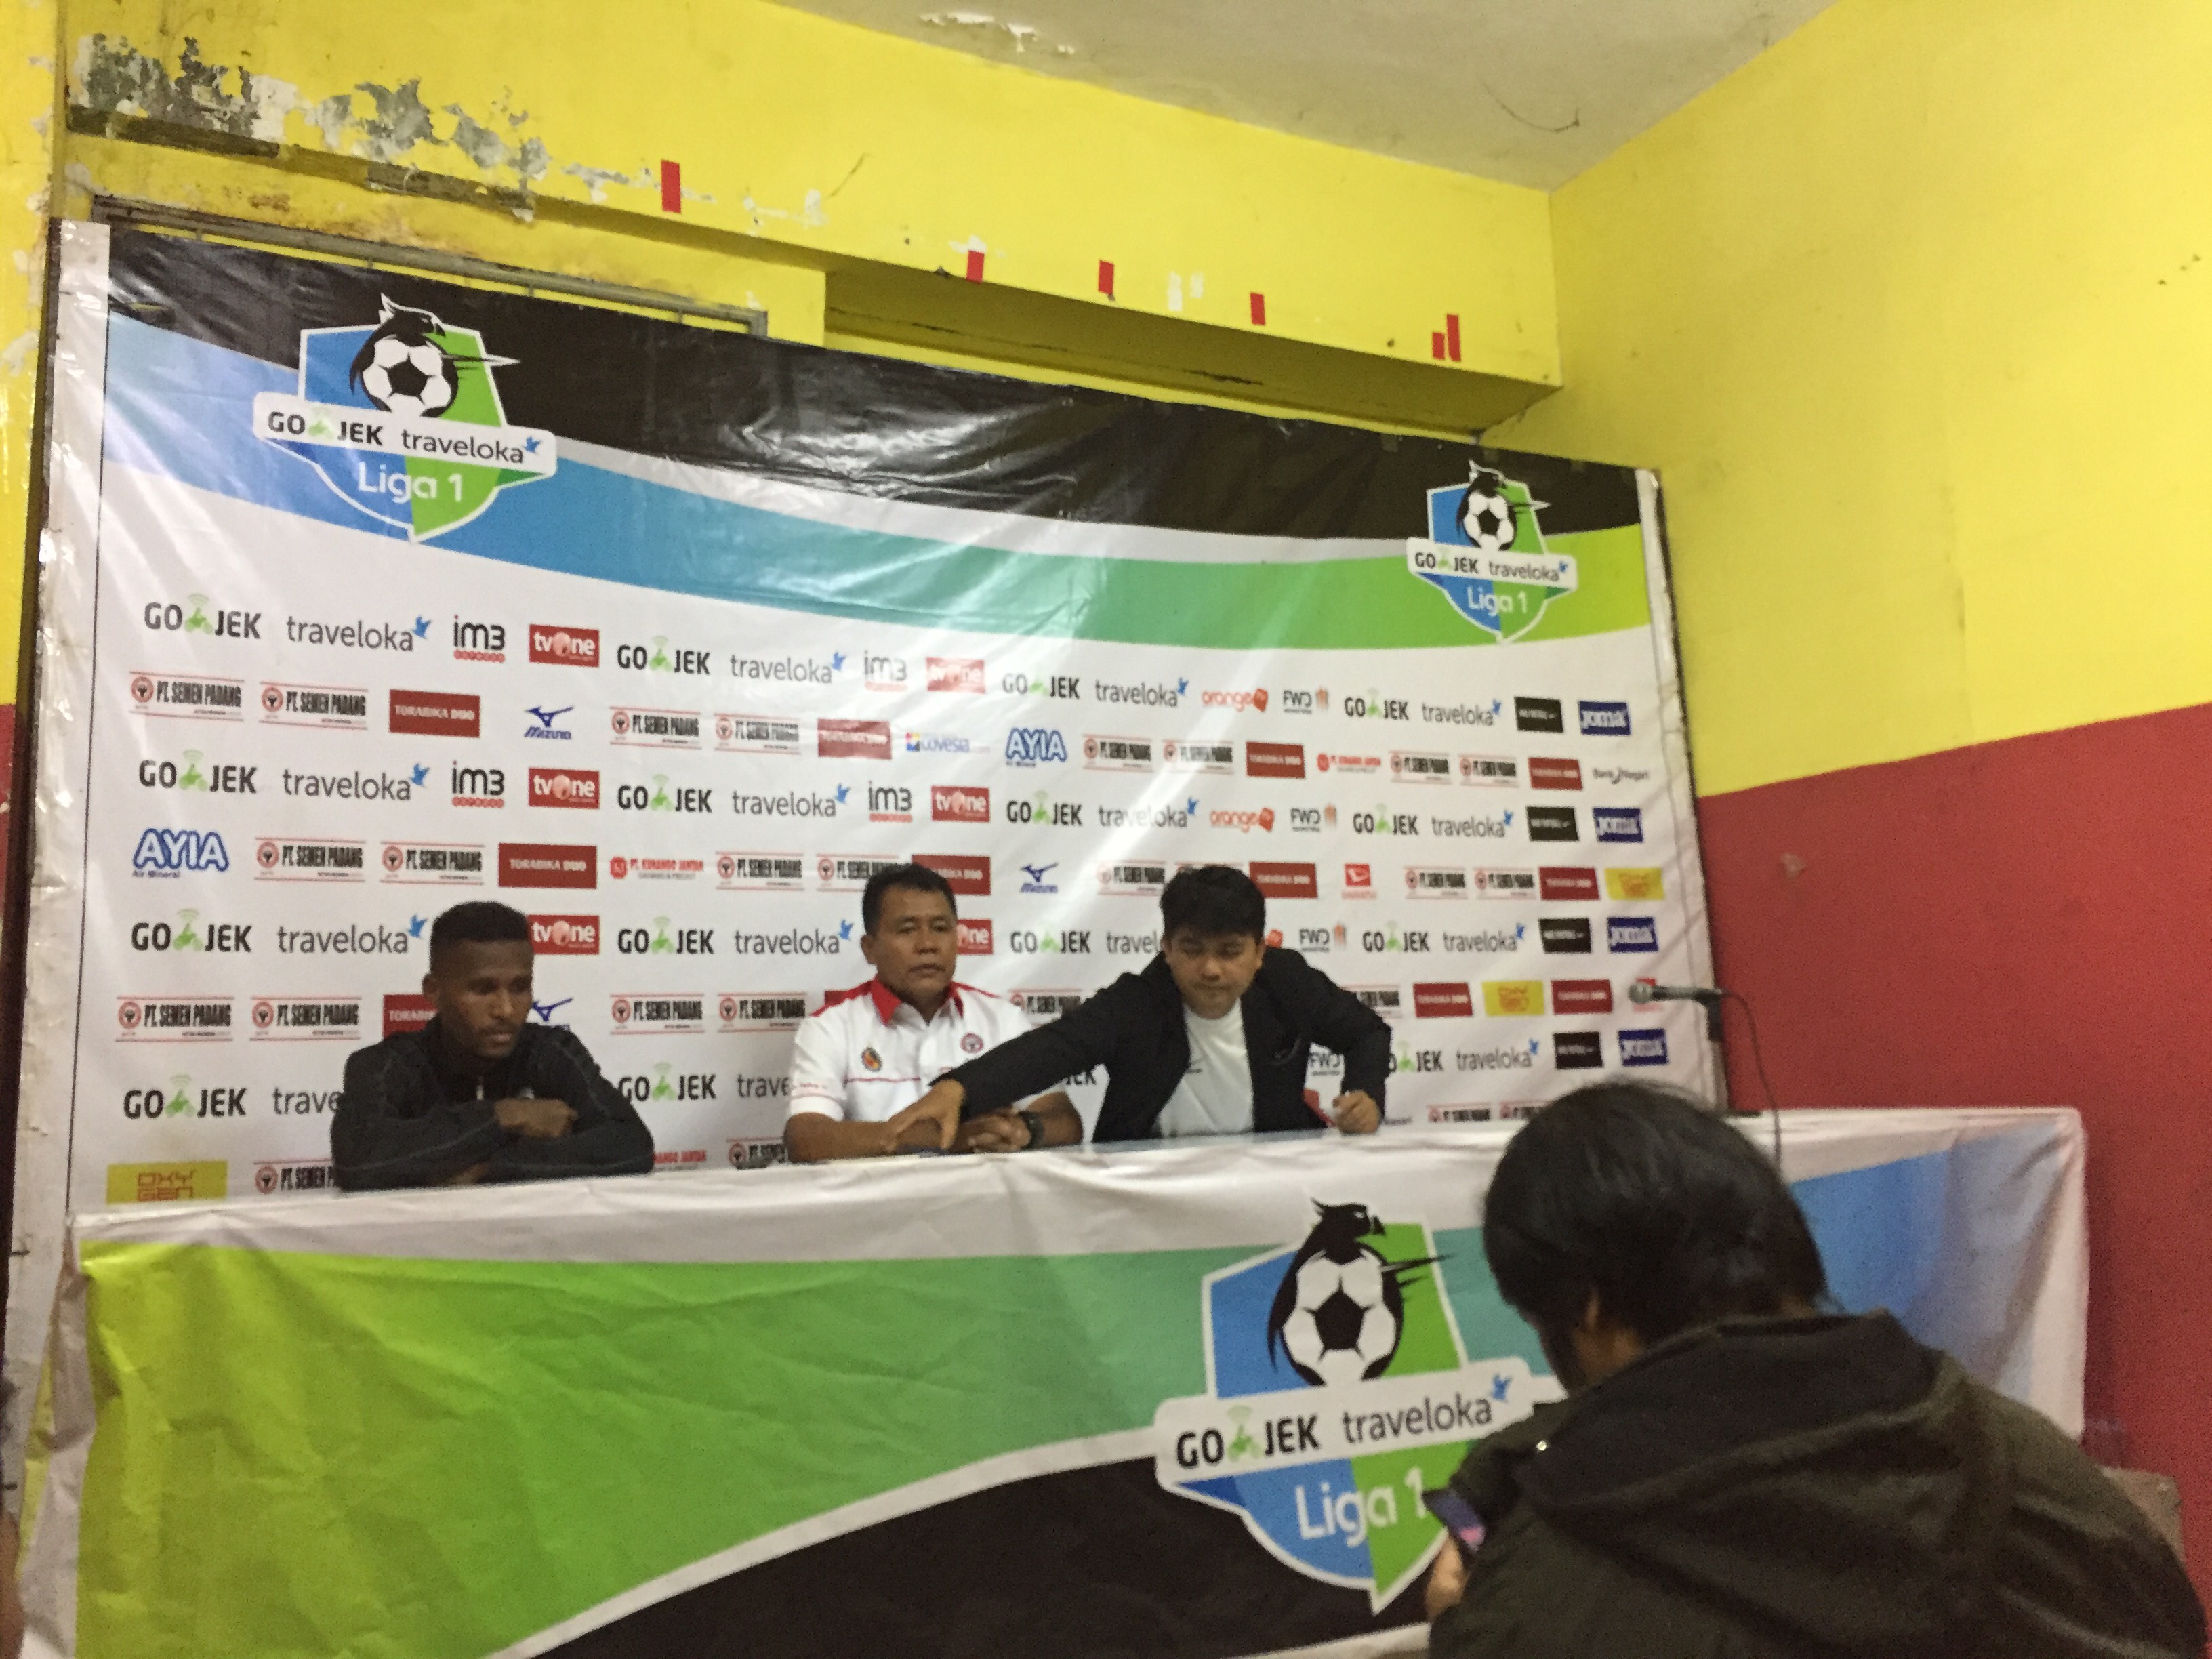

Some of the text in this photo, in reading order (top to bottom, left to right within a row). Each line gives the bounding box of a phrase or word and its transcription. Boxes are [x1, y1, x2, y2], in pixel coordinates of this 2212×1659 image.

[268, 411, 523, 464] GO JEK traveloka
[359, 462, 463, 504] Liga 1
[1489, 560, 1559, 582] traveloka
[1467, 586, 1528, 617] Liga 1
[286, 615, 413, 651] traveloka
[453, 614, 505, 651] im3
[533, 631, 595, 657] tvOne
[731, 654, 832, 684] traveloka
[864, 650, 907, 682] im3
[1095, 678, 1178, 708] traveloka
[1422, 702, 1494, 726] traveloka
[1006, 728, 1067, 762] AYIA
[283, 768, 411, 801] traveloka
[452, 760, 504, 796] im3
[533, 775, 595, 800] tvOne
[733, 790, 836, 817] traveloka
[868, 780, 912, 811] im3
[1432, 815, 1505, 838] traveloka
[133, 828, 229, 872] AYIA
[277, 924, 408, 954] traveloka
[532, 920, 596, 946] tvOne
[735, 928, 840, 955] traveloka
[1107, 929, 1160, 954] travel
[1443, 930, 1517, 952] traveloka
[1456, 1047, 1532, 1071] traveloka
[737, 1073, 790, 1098] trave
[272, 1088, 341, 1115] trave
[1176, 1394, 1492, 1469] GO JEK traveloka
[1295, 1467, 1426, 1547] Liga 1
